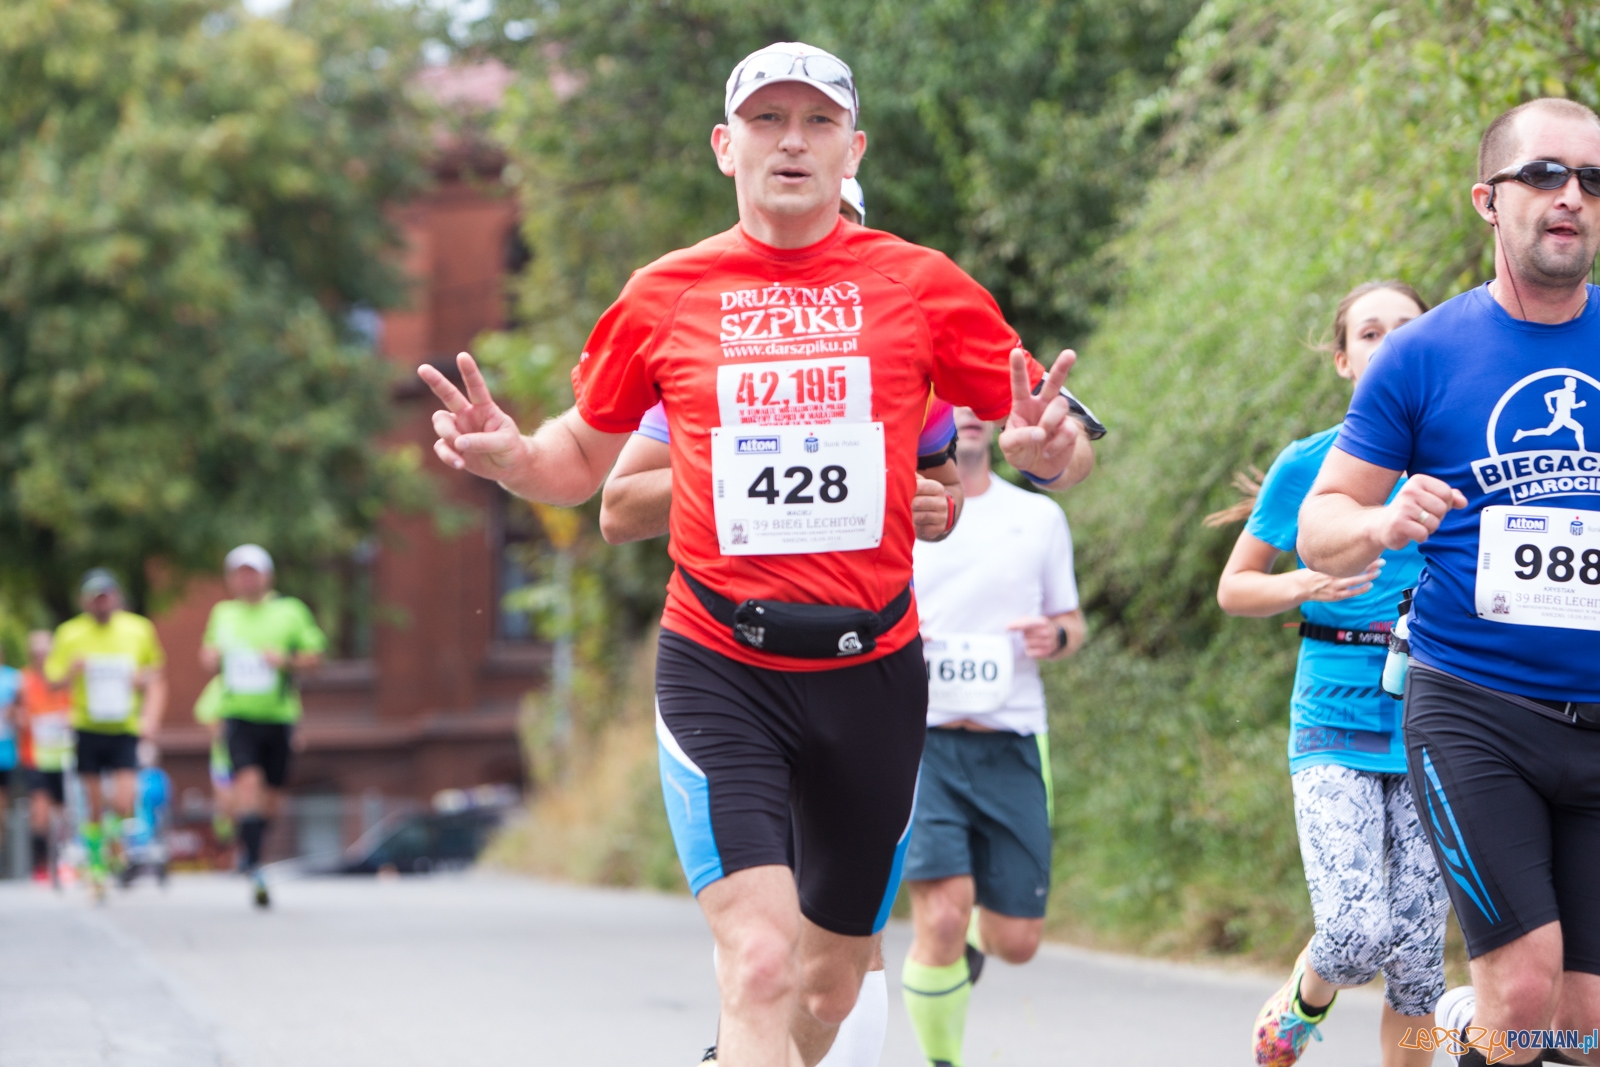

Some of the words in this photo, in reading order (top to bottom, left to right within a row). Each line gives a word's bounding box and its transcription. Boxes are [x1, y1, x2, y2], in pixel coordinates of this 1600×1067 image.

[720, 282, 838, 311] DRUŻYNA
[720, 305, 864, 342] SZPIKU
[722, 338, 858, 358] www.darszpiku.pl
[736, 365, 847, 407] 42,195
[748, 465, 848, 505] 428
[1479, 454, 1600, 487] BIEGAC
[1516, 476, 1600, 499] JAROCI
[752, 519, 769, 530] 39
[772, 518, 803, 529] BIEG
[806, 514, 869, 529] LECHITÓW
[1514, 543, 1600, 585] 988
[1533, 593, 1561, 605] BIEG
